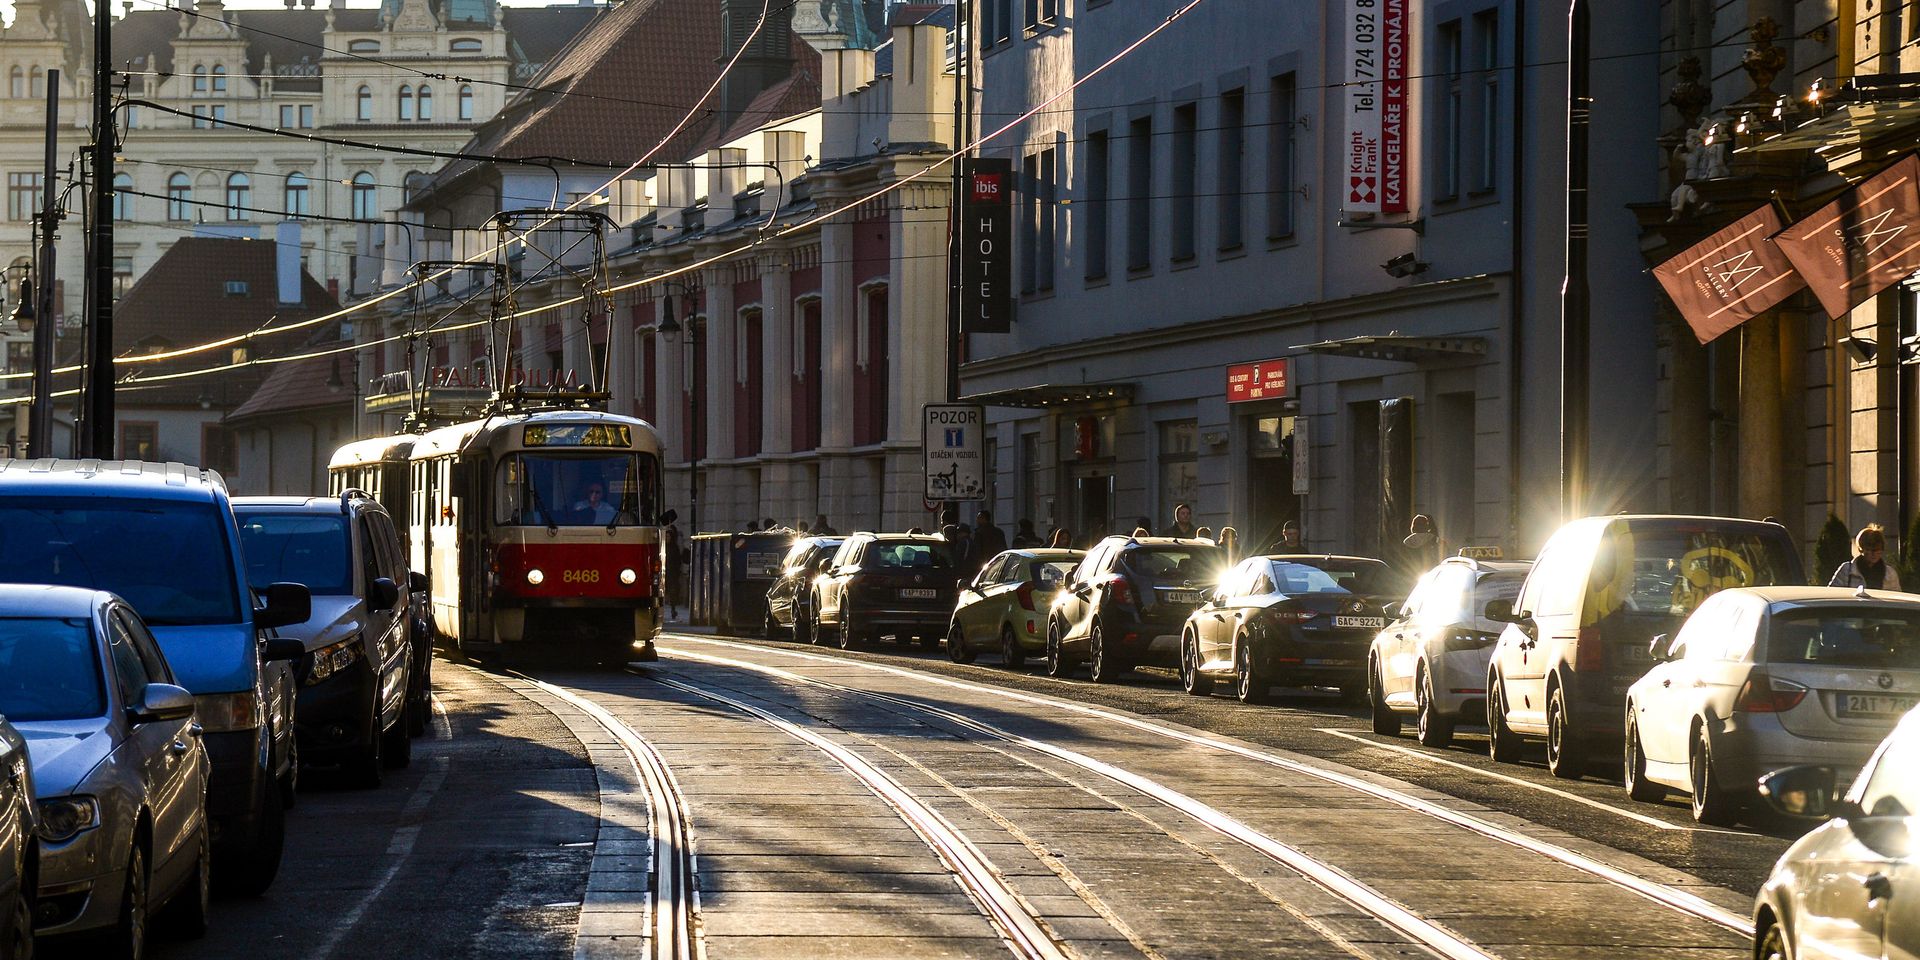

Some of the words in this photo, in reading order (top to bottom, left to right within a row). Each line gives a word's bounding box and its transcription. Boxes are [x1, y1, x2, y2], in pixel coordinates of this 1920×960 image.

[1356, 14, 1374, 43] 032
[1355, 49, 1374, 77] 724
[1388, 86, 1401, 98] K
[1350, 130, 1366, 174] Knight
[1365, 138, 1377, 174] Frank
[1384, 104, 1401, 204] KANCELÁŘE
[975, 180, 998, 193] ibis
[979, 217, 993, 319] HOTEL
[1703, 266, 1729, 298] GALLERY
[432, 367, 578, 388] PALLDIUM
[930, 411, 977, 424] POZOR
[930, 450, 954, 460] OTÁČENÍ
[956, 451, 979, 460] VOZIDEL
[1467, 549, 1497, 558] TAXI
[563, 569, 600, 583] 8468
[1337, 617, 1354, 627] 6AC
[1359, 618, 1381, 627] 9224
[1850, 696, 1877, 711] 2AT
